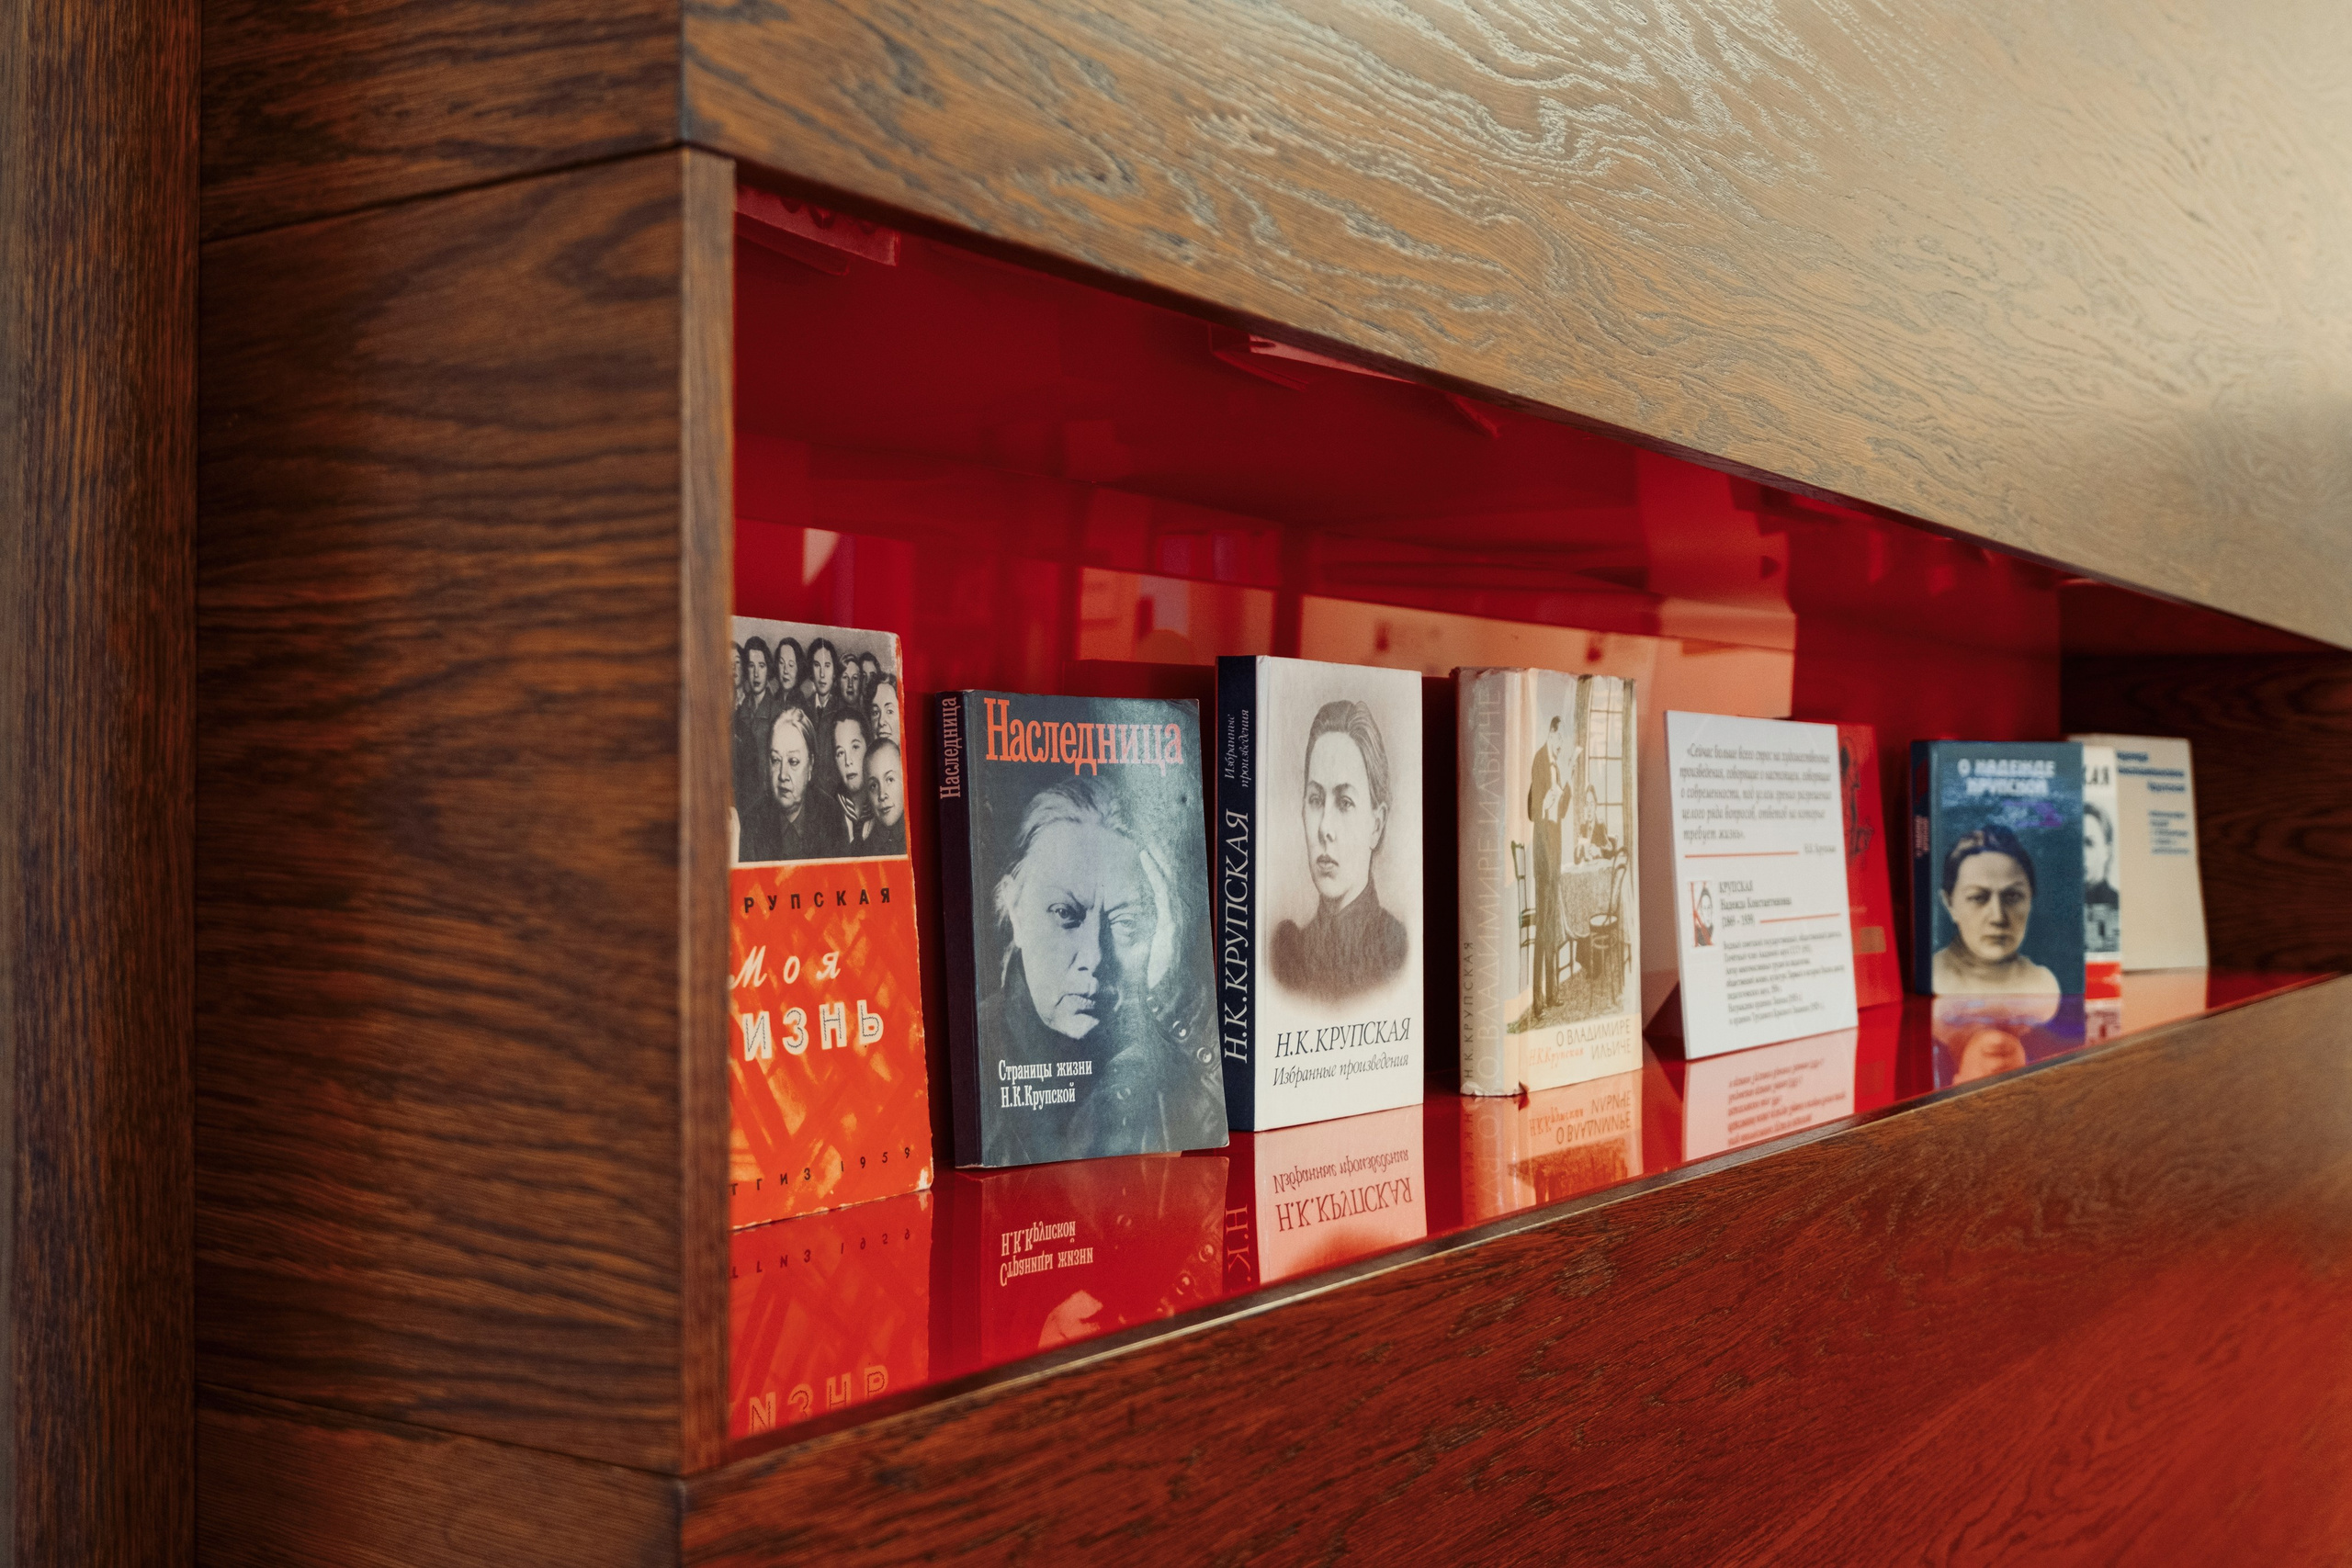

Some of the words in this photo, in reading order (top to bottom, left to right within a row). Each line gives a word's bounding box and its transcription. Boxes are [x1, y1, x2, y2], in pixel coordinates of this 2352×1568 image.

[940, 697, 962, 799] Наследница
[984, 697, 1183, 777] Наследница
[1225, 714, 1236, 779] Избранные
[1238, 709, 1250, 788] произведения
[744, 887, 890, 913] РУПСКАЯ
[729, 945, 841, 989] Моя
[741, 999, 884, 1062] ИЗНЬ
[999, 1060, 1052, 1085] Страницы
[1057, 1060, 1092, 1077] жизни
[1272, 1065, 1337, 1088] Избранные
[1340, 1051, 1408, 1080] произведения
[730, 1168, 810, 1195] ТГИЗ
[841, 1147, 910, 1172] 1959
